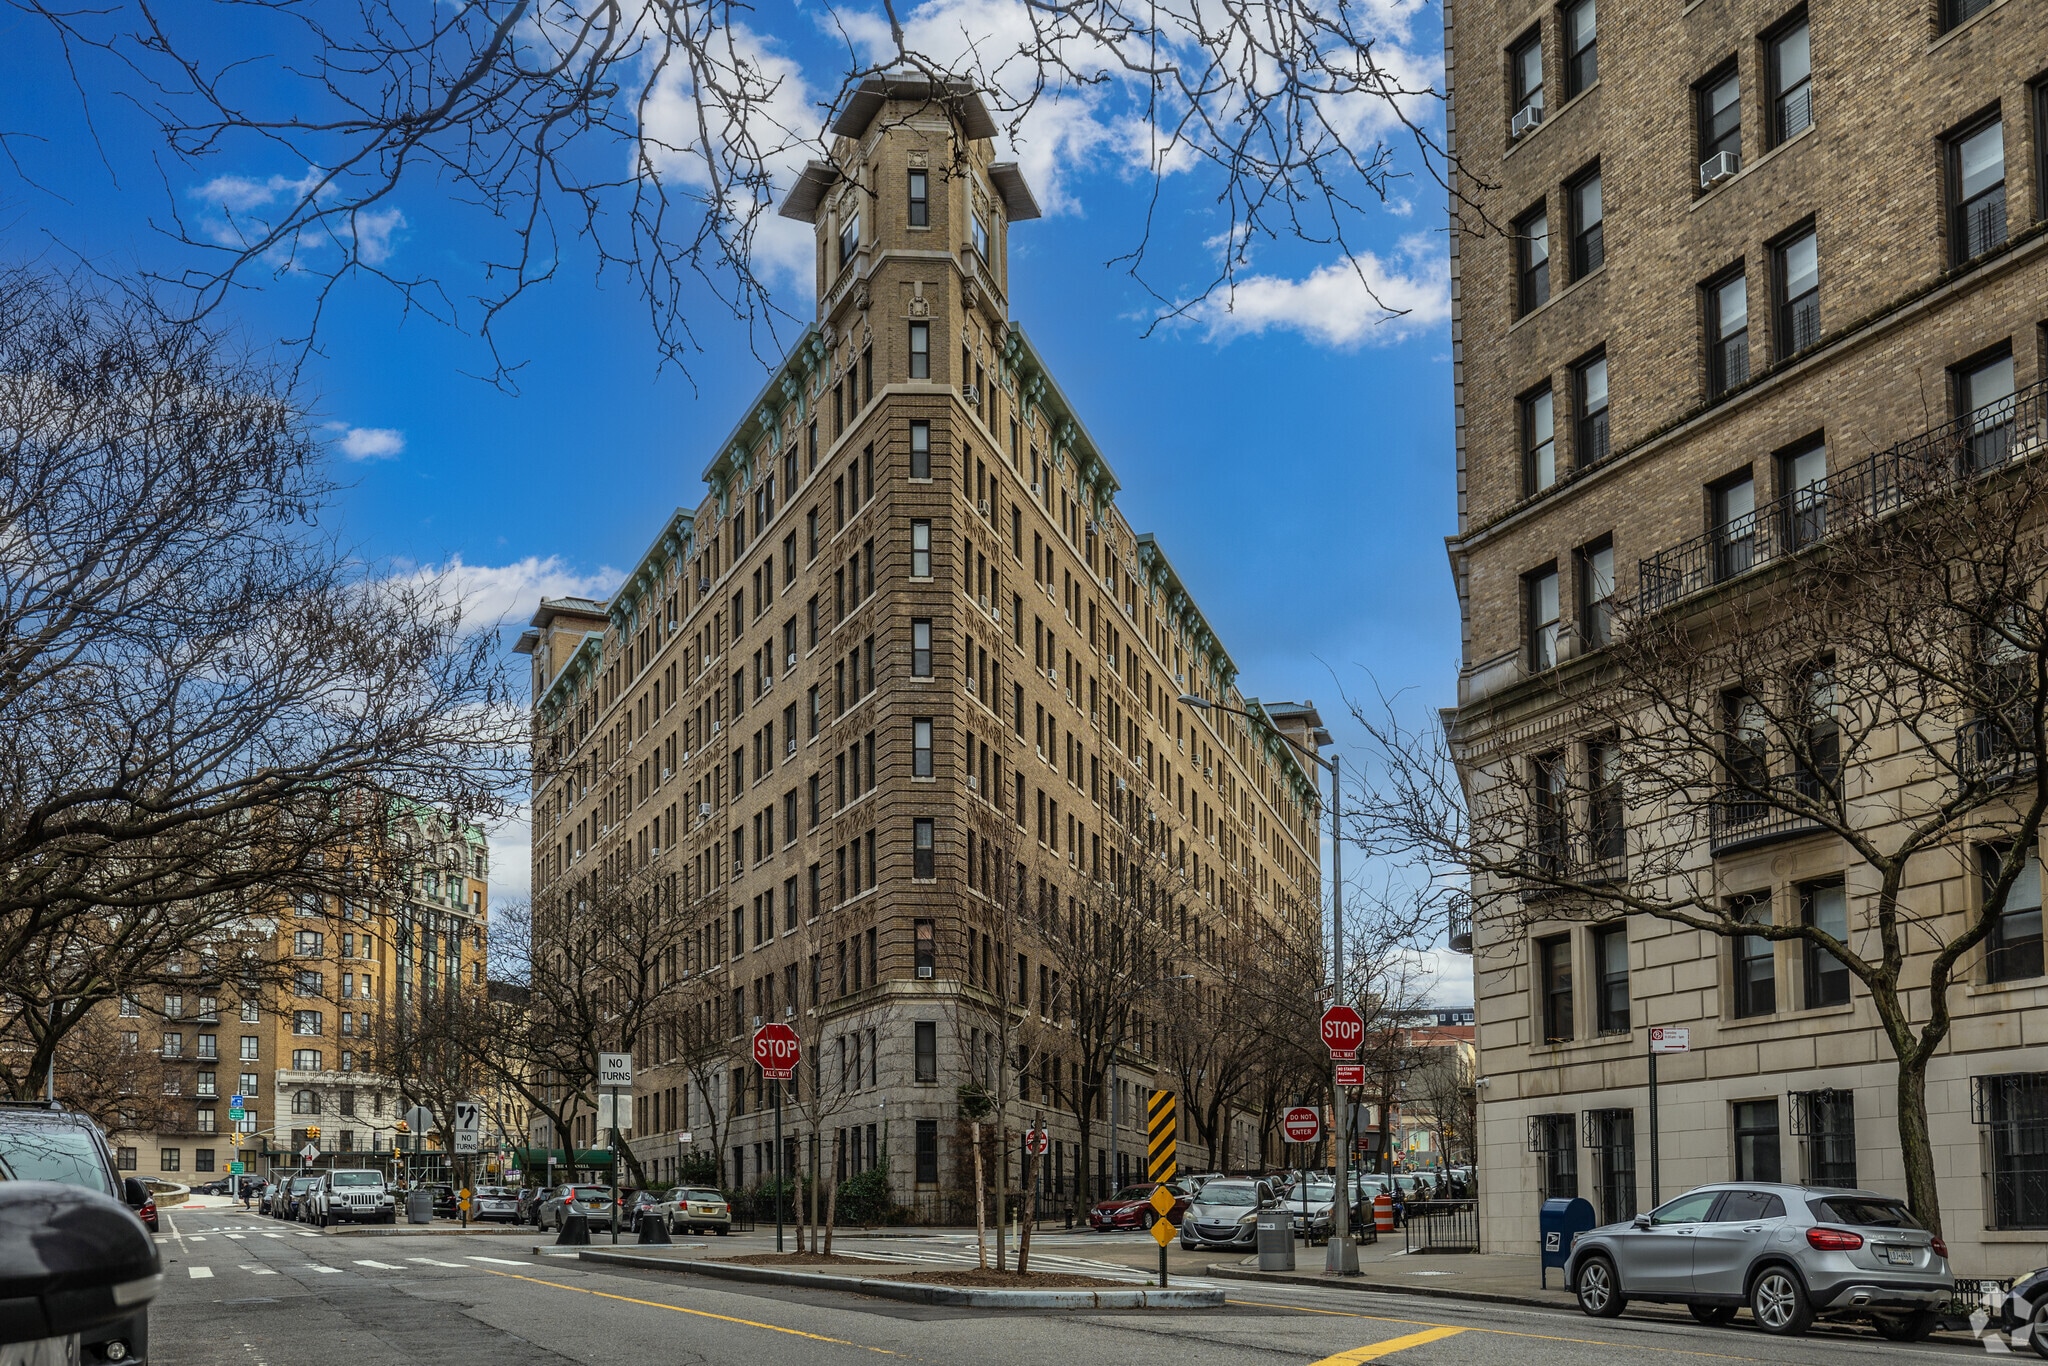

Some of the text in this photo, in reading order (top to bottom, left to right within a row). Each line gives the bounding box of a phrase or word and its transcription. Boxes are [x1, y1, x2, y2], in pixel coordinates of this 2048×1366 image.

[1314, 990, 1319, 1002] W
[1320, 988, 1328, 1000] 157
[1325, 1020, 1360, 1039] STOP
[757, 1039, 797, 1058] STOP
[609, 1059, 622, 1068] NO
[602, 1072, 630, 1080] TURNS
